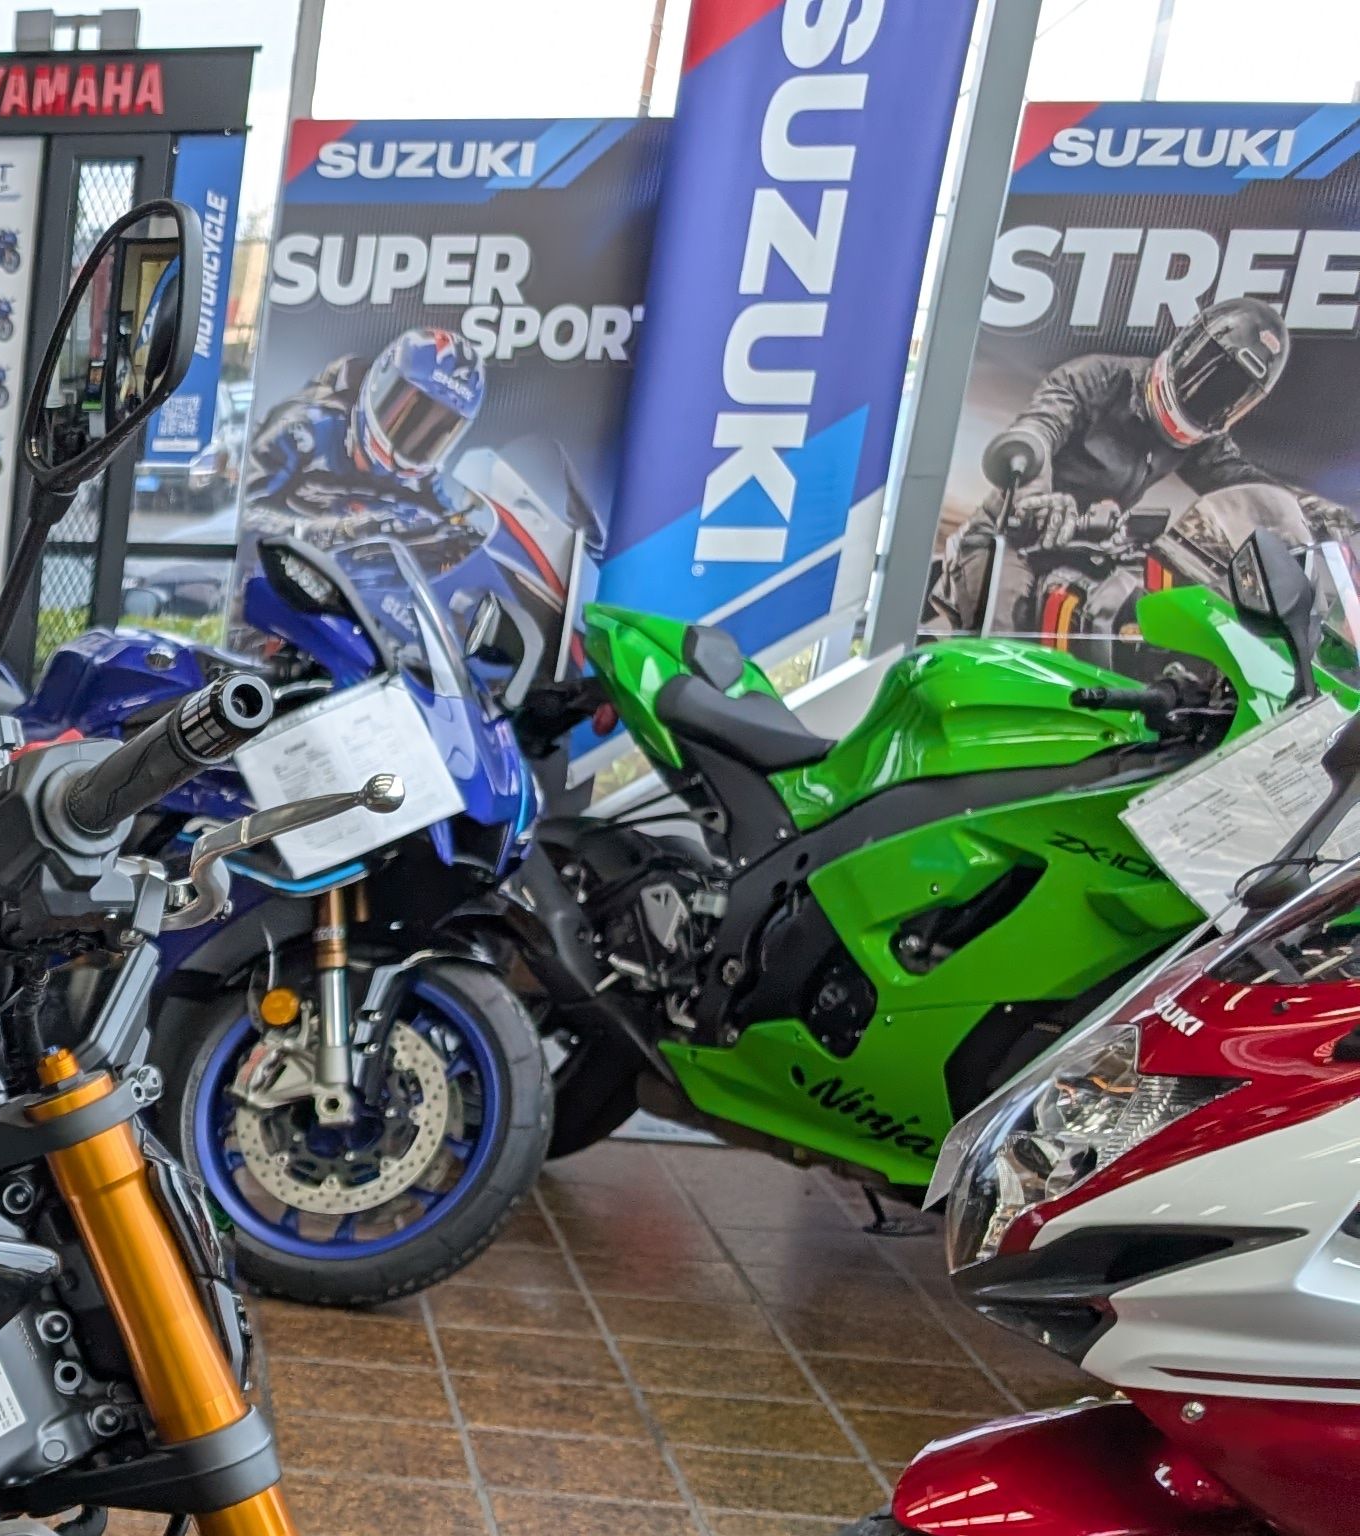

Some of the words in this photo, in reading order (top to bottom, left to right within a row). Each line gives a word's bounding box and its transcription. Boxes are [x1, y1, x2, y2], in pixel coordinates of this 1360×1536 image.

[316, 142, 538, 179] SUZUKI
[1049, 127, 1298, 168] SUZUKI
[194, 189, 229, 358] MOTORCYCLE
[268, 233, 531, 307] SUPER
[694, 0, 884, 563] SUZUKI
[460, 303, 645, 362] SPOR
[791, 1064, 942, 1161] Ninja
